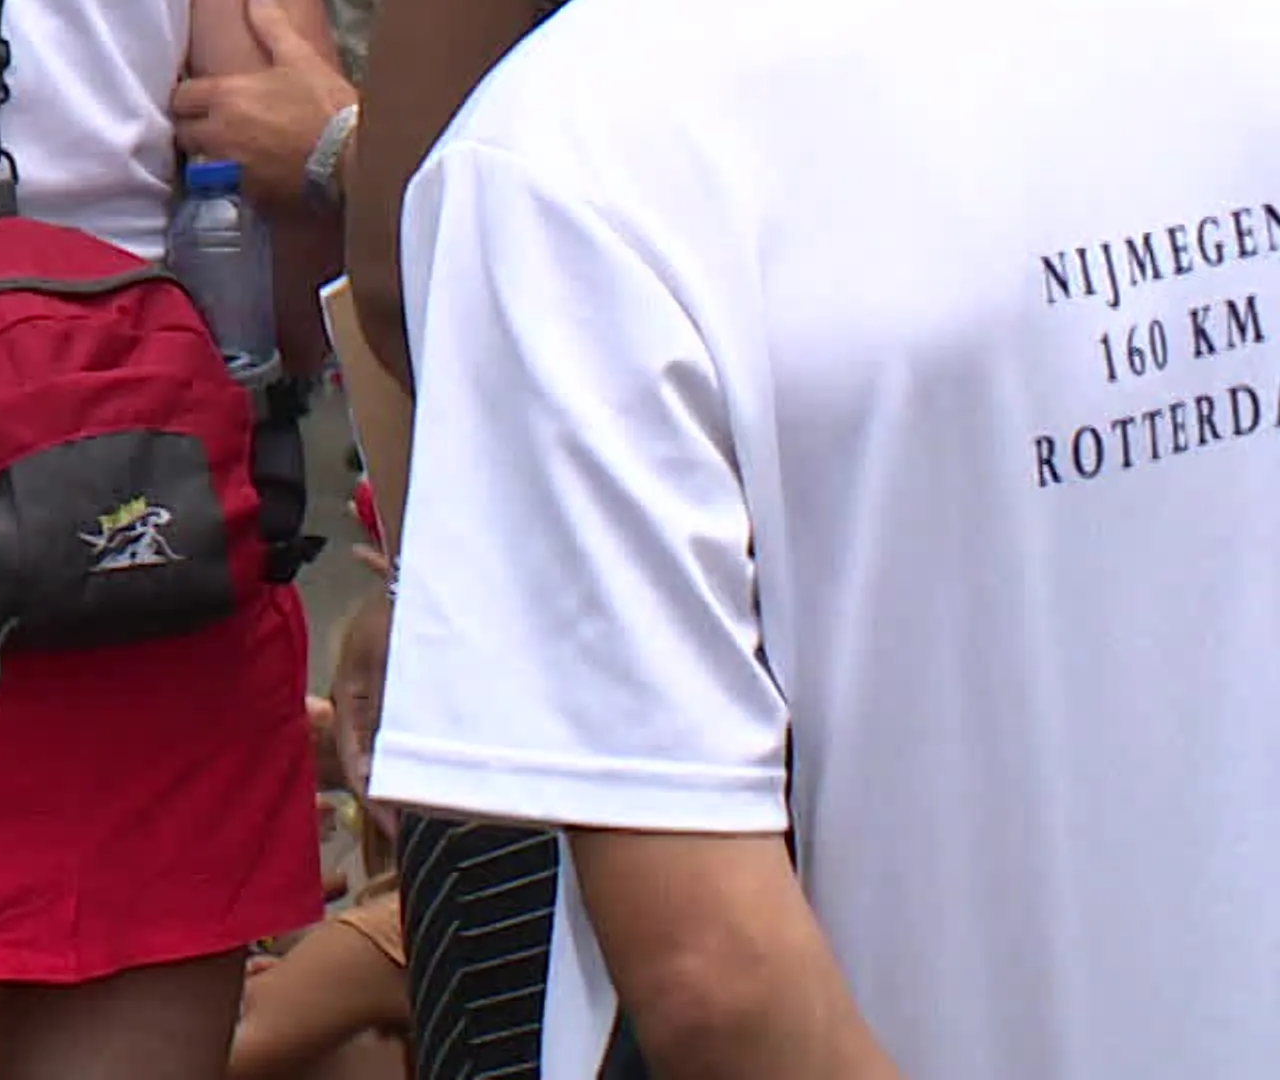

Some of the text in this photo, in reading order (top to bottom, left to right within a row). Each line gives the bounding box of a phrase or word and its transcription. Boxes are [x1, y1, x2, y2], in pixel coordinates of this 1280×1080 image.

[1040, 203, 1280, 310] NIJMEGEN
[1100, 293, 1265, 384] 160 KM
[1034, 383, 1280, 488] ROTTERD
